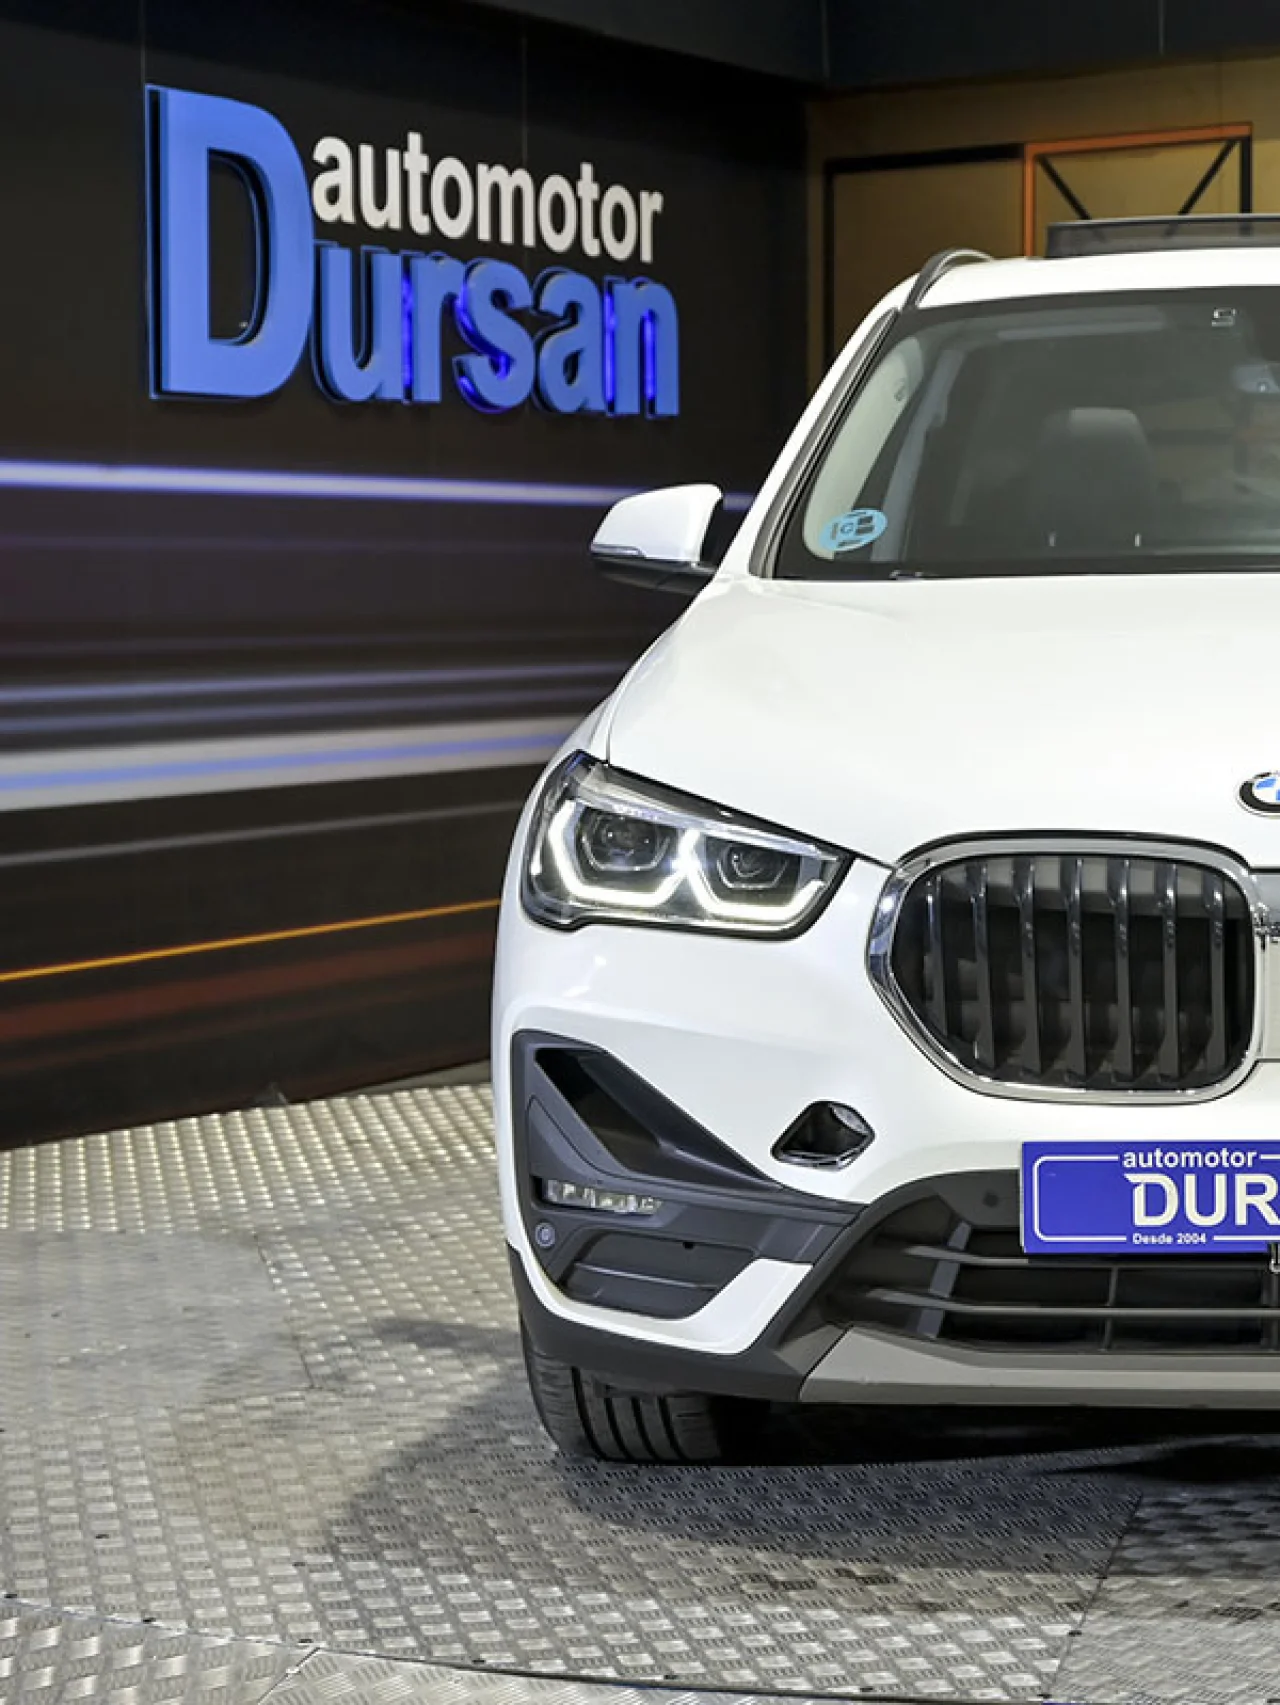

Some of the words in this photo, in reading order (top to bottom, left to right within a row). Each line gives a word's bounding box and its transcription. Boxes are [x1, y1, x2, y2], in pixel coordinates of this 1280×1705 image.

[312, 131, 663, 263] automotor
[145, 84, 679, 417] Dursan
[1123, 1148, 1257, 1168] automotor
[1132, 1233, 1173, 1244] Desde
[1177, 1233, 1206, 1244] 2004
